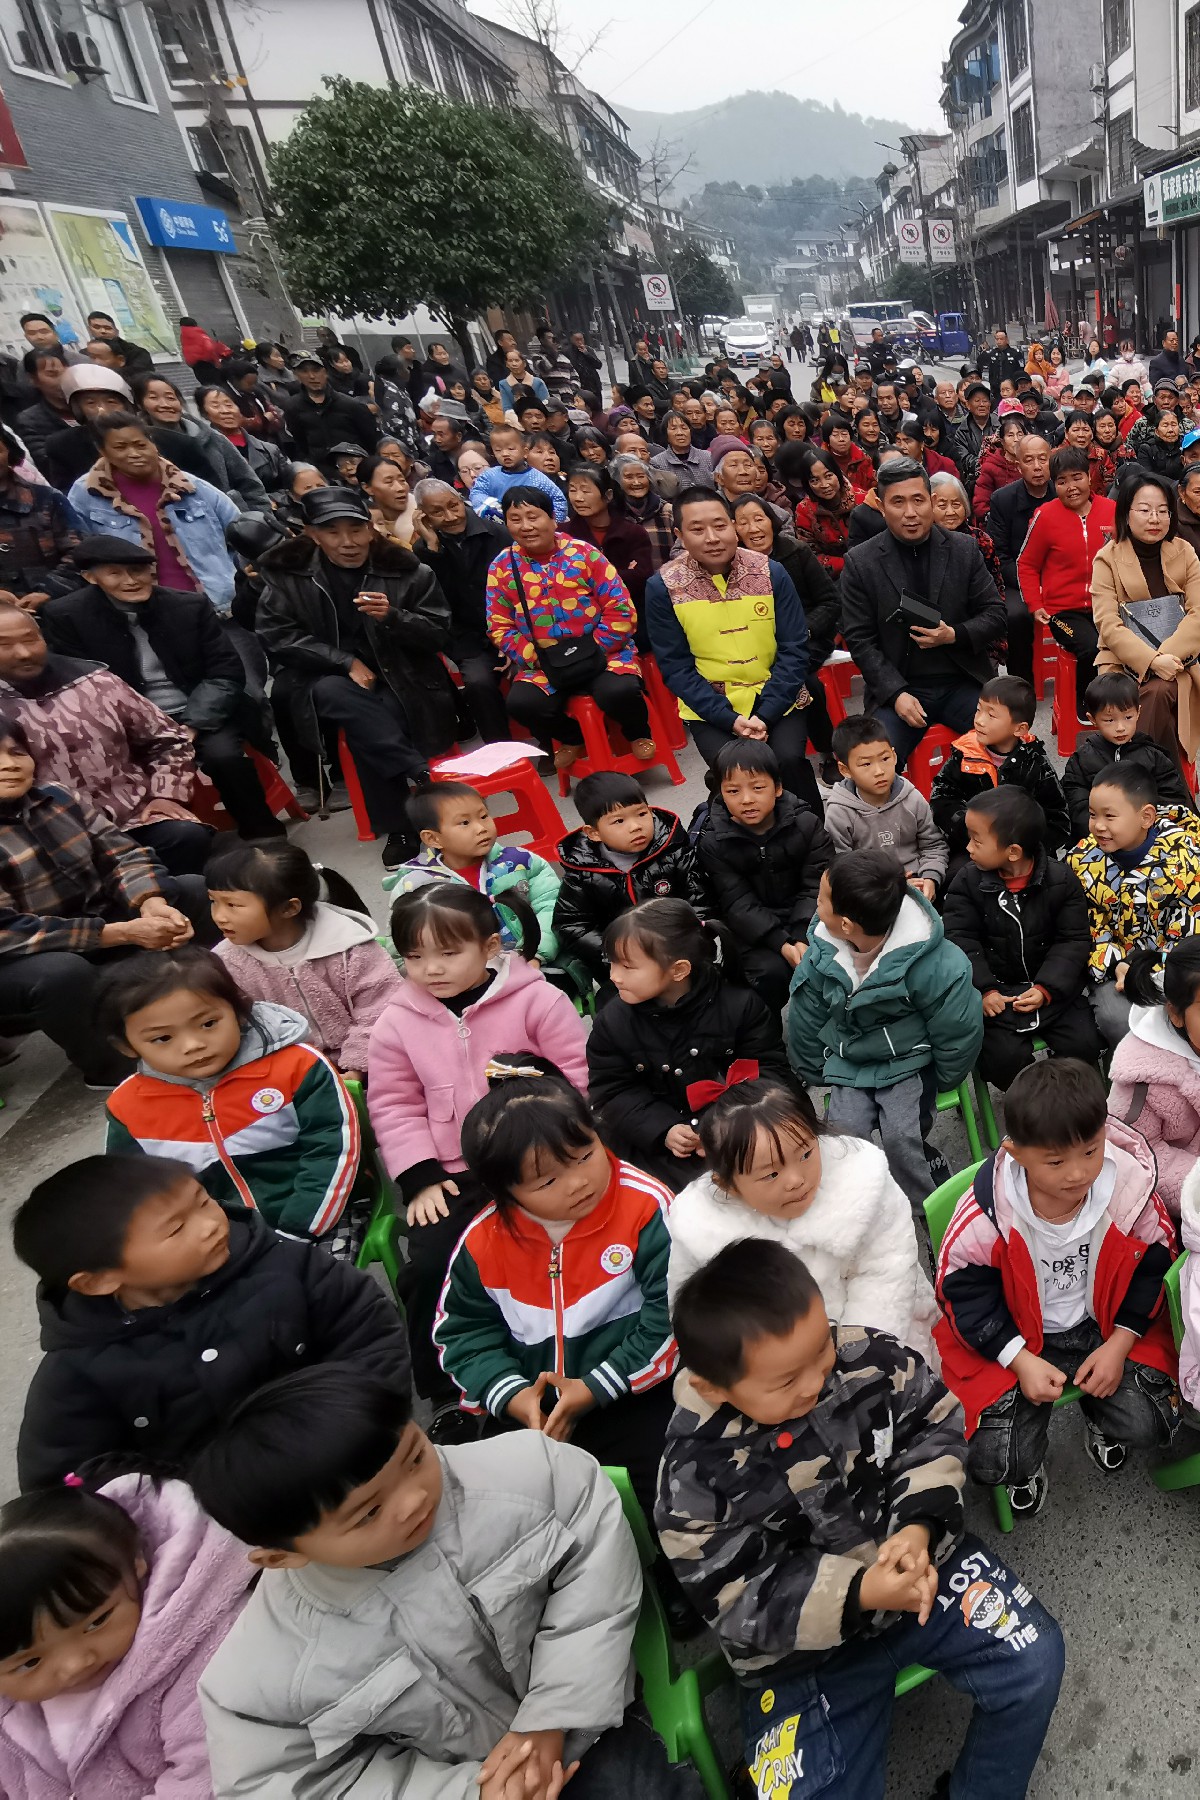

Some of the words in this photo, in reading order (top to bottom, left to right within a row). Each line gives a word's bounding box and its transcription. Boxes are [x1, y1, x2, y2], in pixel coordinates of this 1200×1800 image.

[937, 1551, 990, 1612] LOST
[1004, 1623, 1039, 1652] THE
[757, 1748, 804, 1800] CRAY
